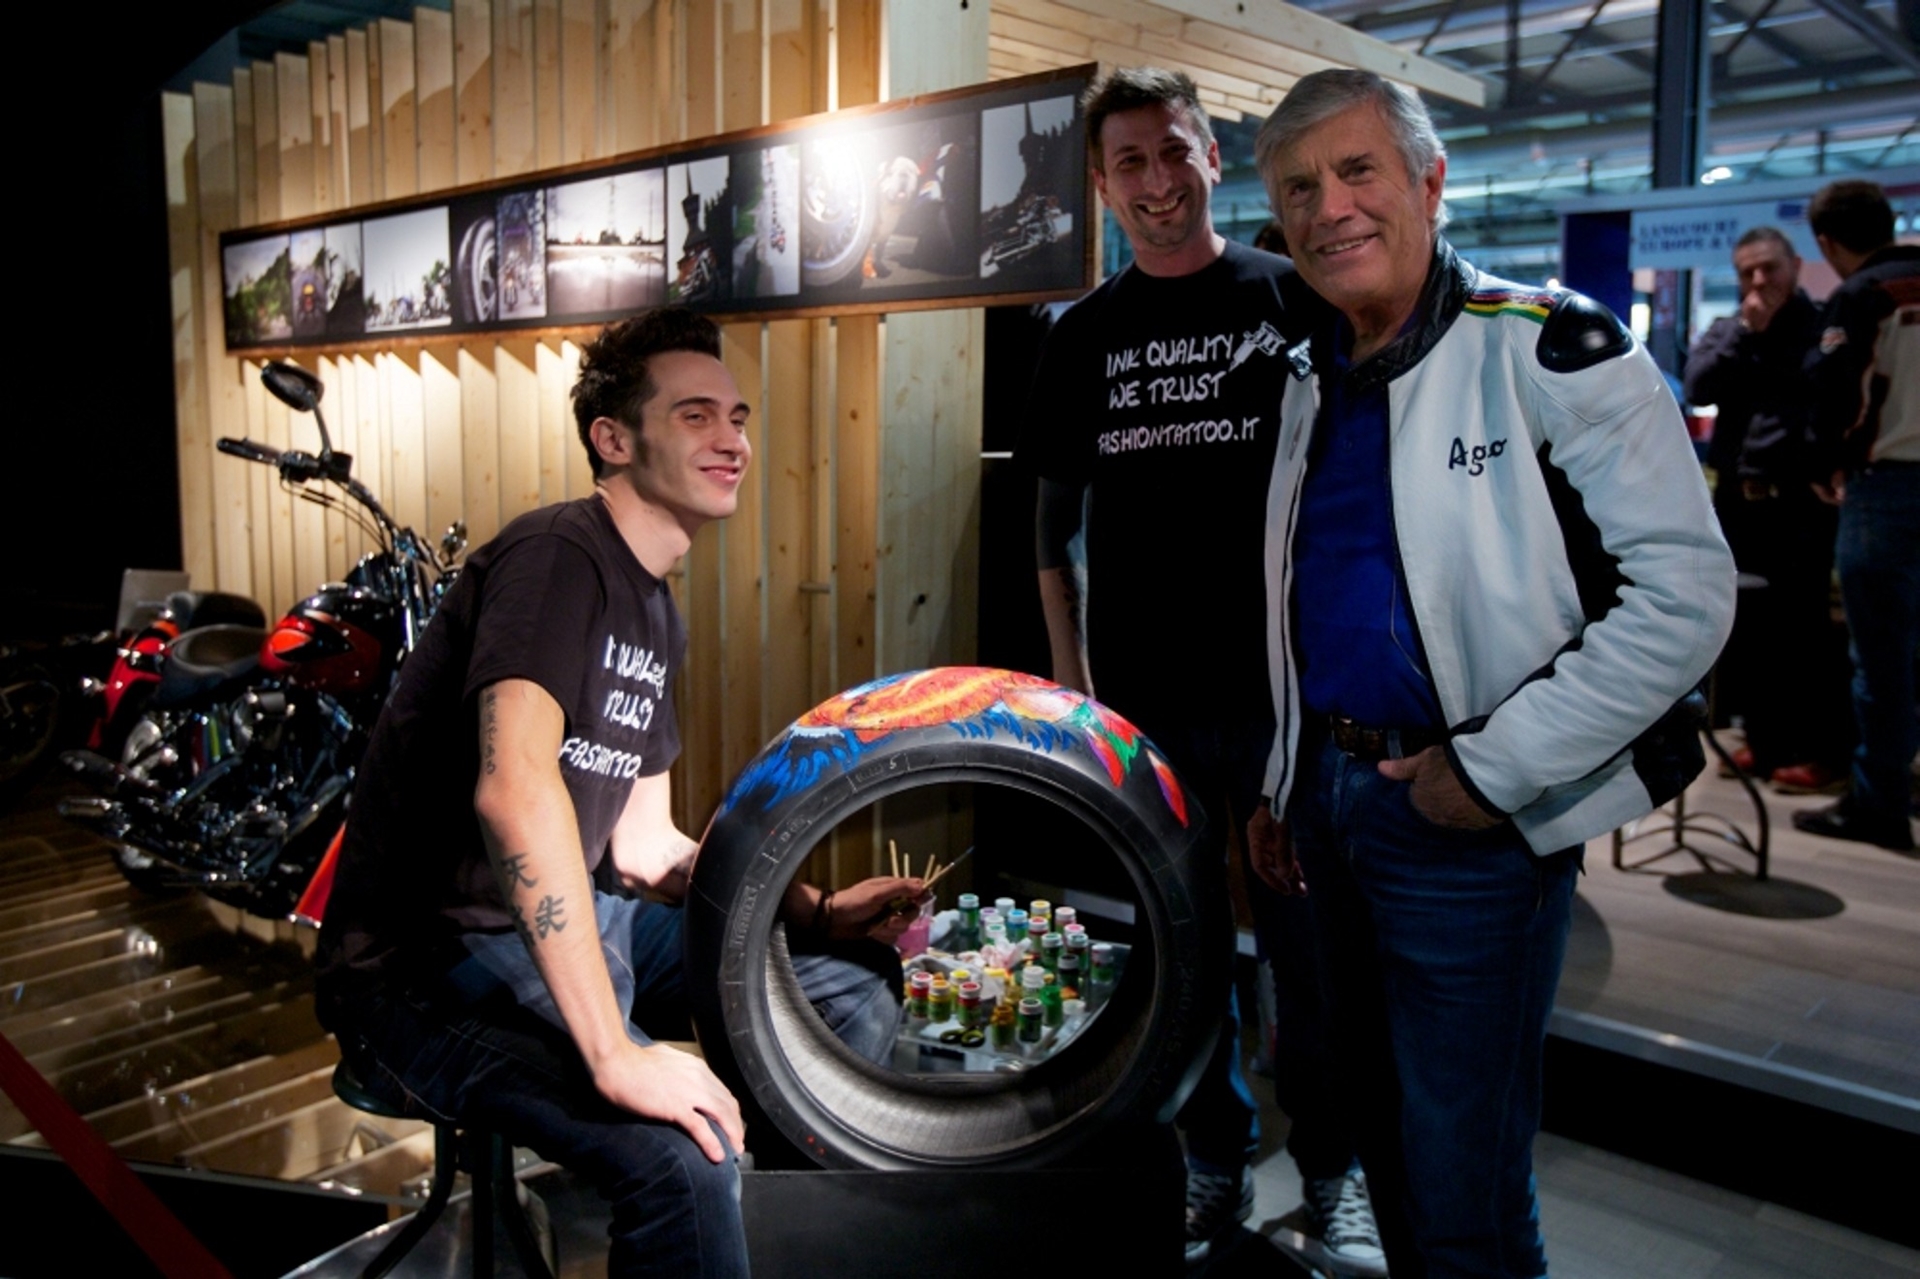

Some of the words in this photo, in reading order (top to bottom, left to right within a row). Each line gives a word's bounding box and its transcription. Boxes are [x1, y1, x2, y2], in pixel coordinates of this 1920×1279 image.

[1106, 348, 1141, 378] INK
[1145, 333, 1234, 367] QUALITY
[1108, 380, 1141, 410] WE
[1147, 371, 1228, 404] TRUST
[1448, 436, 1508, 477] Ago
